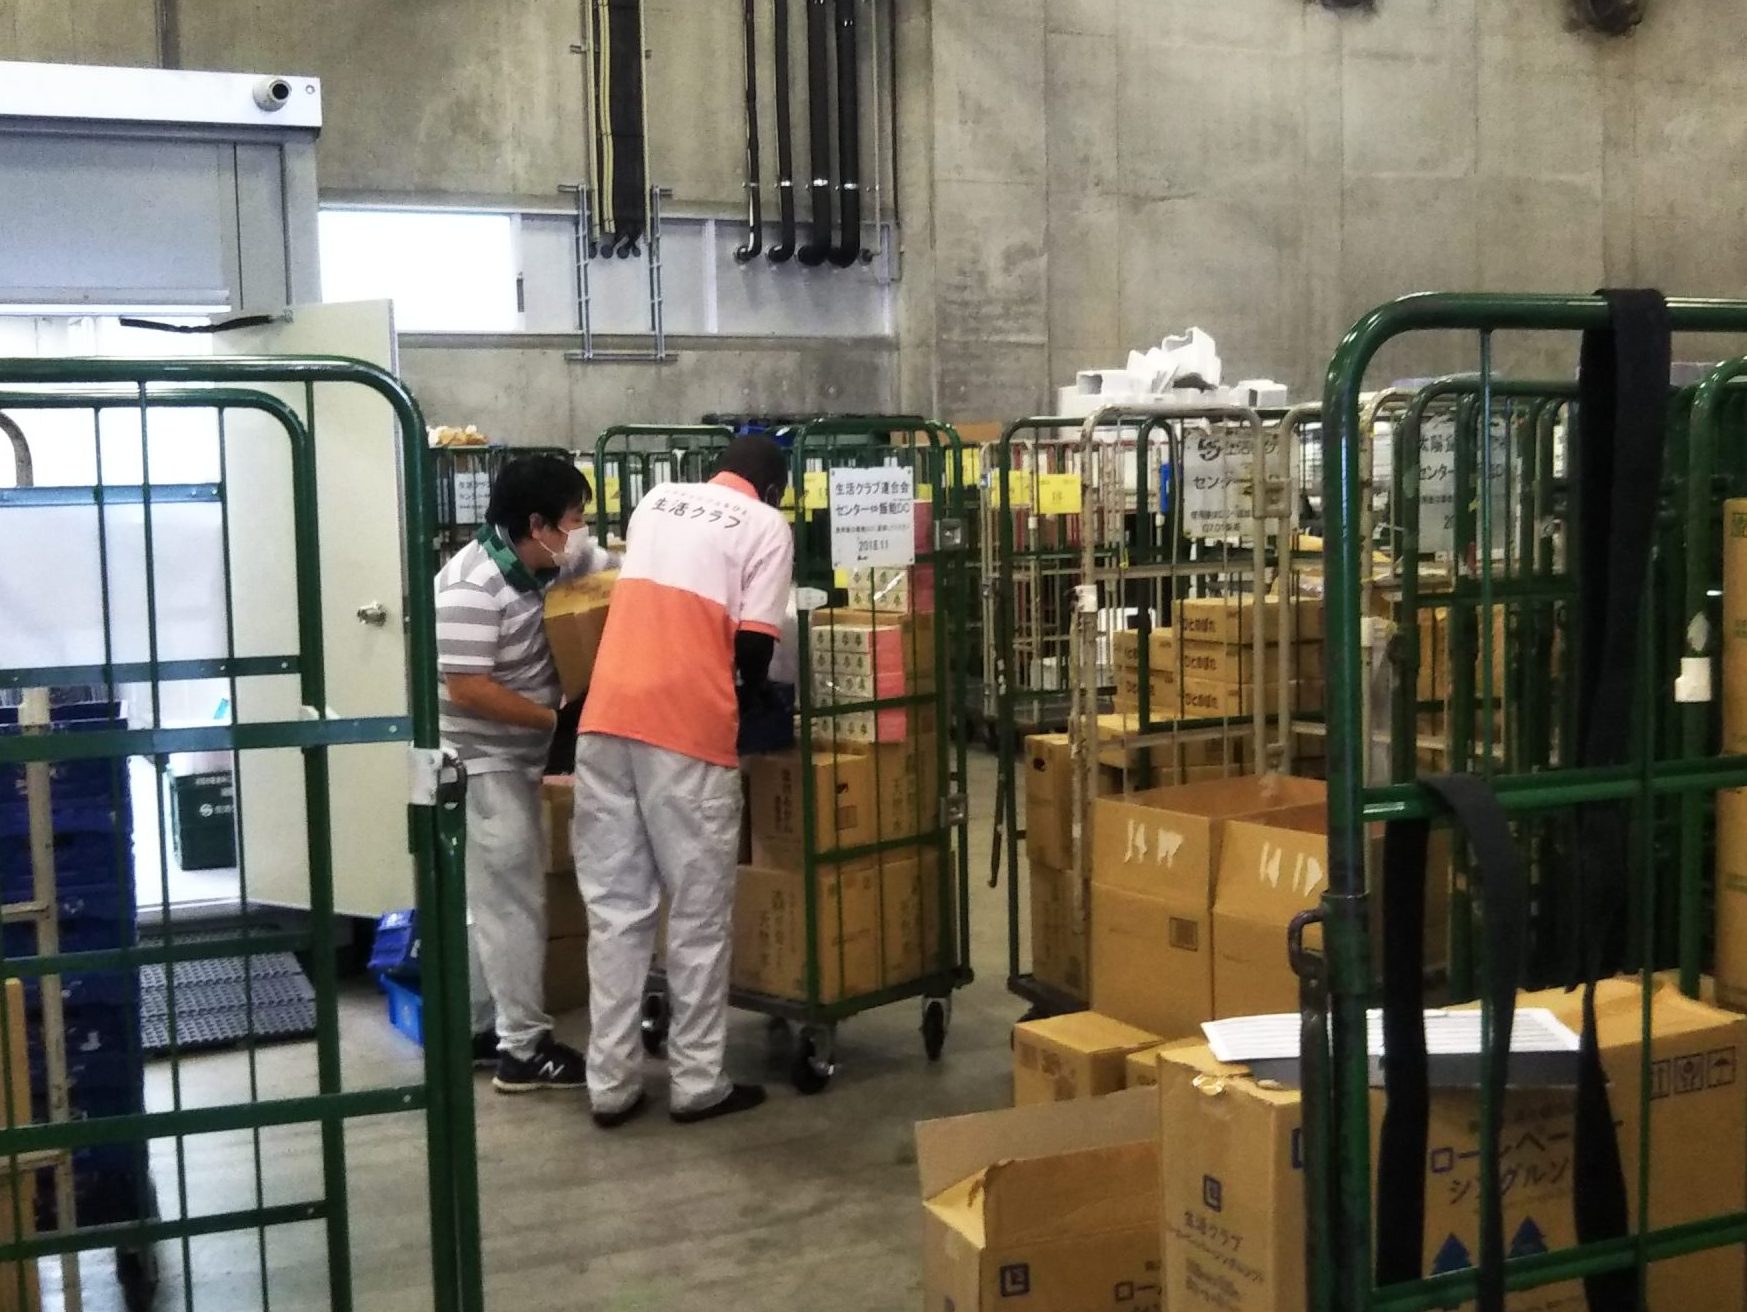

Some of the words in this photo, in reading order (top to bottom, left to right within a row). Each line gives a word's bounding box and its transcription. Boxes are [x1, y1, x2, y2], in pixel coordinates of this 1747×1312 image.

[836, 481, 909, 496] 生活クラブ連合会
